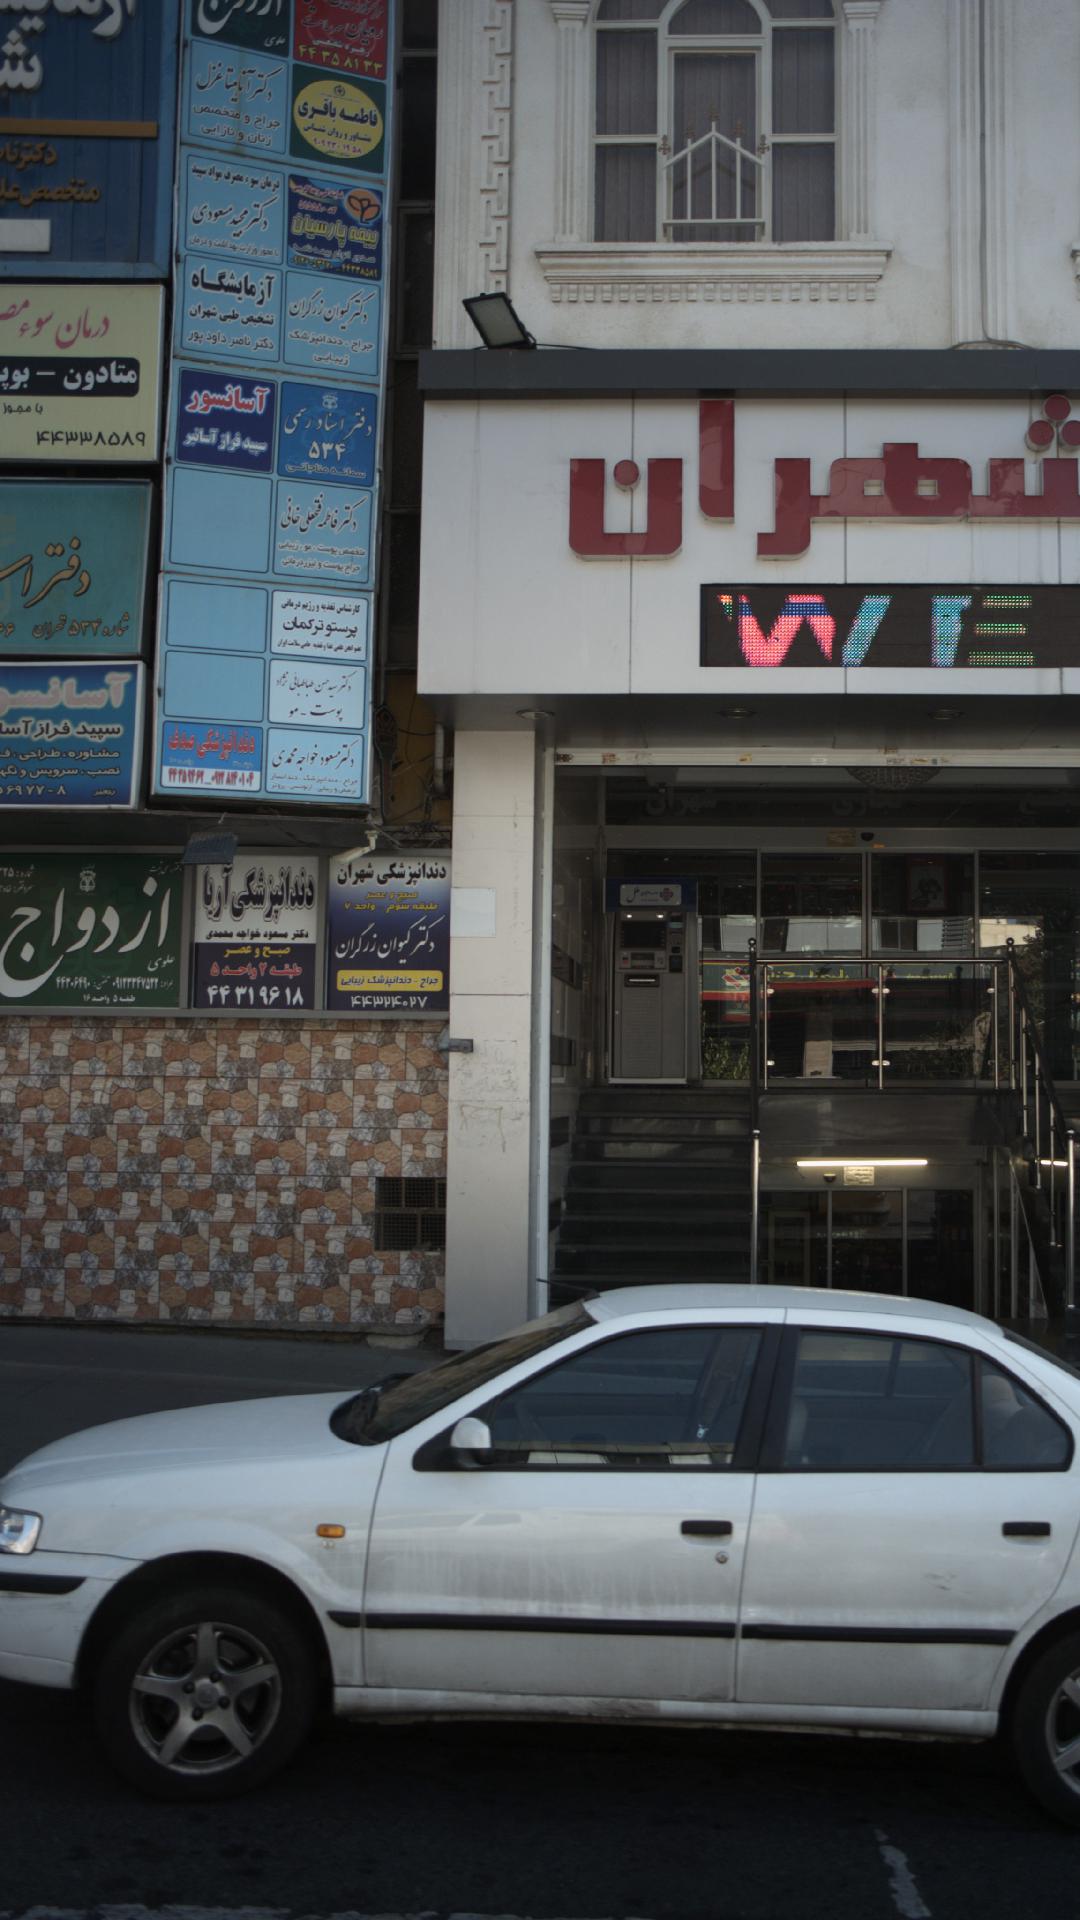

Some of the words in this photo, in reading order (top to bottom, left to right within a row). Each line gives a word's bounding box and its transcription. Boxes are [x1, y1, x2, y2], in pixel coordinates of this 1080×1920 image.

[247, 65, 283, 102] دکتر
[193, 104, 241, 119] متخصص
[243, 114, 250, 123] و
[298, 98, 336, 122] باقری
[339, 107, 377, 127] فاطمه
[254, 115, 280, 129] جراح
[238, 133, 244, 142] و
[247, 133, 272, 147] زنان
[16, 141, 57, 170] دکتر
[208, 166, 222, 181] مواد
[20, 178, 101, 206] متخصص
[260, 176, 280, 192] درمان
[192, 204, 232, 224] مسعودی
[244, 196, 278, 230] دکتر
[292, 212, 347, 248] پارسیان
[348, 226, 378, 249] بیمه
[191, 268, 275, 305] آزمایشگاه
[0, 299, 30, 320] مص
[188, 304, 218, 319] شهران
[288, 290, 324, 317] زرگران
[323, 291, 362, 330] کیوان
[350, 292, 376, 324] دکتر
[218, 308, 240, 322] طبی
[241, 312, 275, 326] تشخیص
[18, 311, 55, 339] سوء
[55, 307, 110, 349] درمان
[229, 334, 251, 347] ناصر
[253, 338, 275, 350] دکتر
[289, 330, 344, 346] دندانپزشک
[350, 341, 374, 351] جراح
[63, 361, 137, 391] متادون
[186, 384, 270, 414] آسانسور
[35, 402, 44, 415] با
[284, 407, 313, 435] رسمی
[316, 412, 345, 431] اسناد
[342, 407, 372, 441] دفتر
[37, 430, 147, 447] ۴۴۳۳۸۵۸۹
[218, 429, 241, 451] فراز
[308, 440, 346, 461] ۵۳۴
[317, 509, 339, 528] فاطمه
[337, 496, 368, 535] دکتر
[23, 536, 91, 609] دفتر
[281, 598, 301, 609] درمانی
[302, 601, 316, 612] رژیم
[320, 603, 336, 613] تغذیه
[336, 604, 360, 615] کارشناس
[282, 617, 324, 636] ترکمان
[324, 622, 358, 638] پرستو
[336, 670, 358, 693] دکتر
[289, 707, 299, 718] مو
[310, 704, 344, 722] پوست
[0, 719, 32, 735] آسا
[34, 722, 71, 738] فراز
[77, 724, 121, 739] سپید
[196, 728, 255, 760] دندانپزشکی
[19, 748, 60, 761] طراحی
[69, 748, 119, 761] مشاوره
[272, 747, 298, 768] محمدی
[296, 744, 319, 771] خواجه
[320, 750, 341, 766] مسعود
[334, 739, 359, 770] دکتر
[20, 768, 27, 779] و
[29, 766, 78, 779] سرویس
[88, 767, 120, 777] نصب
[337, 862, 374, 886] شهران
[377, 862, 447, 886] دندانپزشکی
[203, 865, 233, 921] آریا
[231, 866, 315, 924] دندانپزشکی
[353, 902, 376, 911] واحد
[0, 876, 171, 998] ازدواج
[206, 929, 234, 940] محمدی
[236, 929, 261, 940] خواجه
[264, 929, 288, 940] مسعود
[291, 929, 309, 940] دکتر
[335, 922, 378, 959] زرگران
[377, 915, 427, 964] کیوان
[409, 915, 446, 957] دکتر
[224, 945, 252, 958] عصر
[254, 947, 260, 958] و
[262, 945, 291, 958] صبح
[146, 954, 176, 972] علوی
[210, 961, 220, 977] ۵
[221, 962, 257, 980] واحد
[269, 962, 303, 979] طبقه
[341, 976, 364, 986] زیبایی
[367, 974, 412, 987] دندانپزشک
[419, 976, 438, 987] جراح
[92, 994, 110, 1004] واحد
[350, 995, 428, 1009] ۴۴۳۲۴۰۲۷
